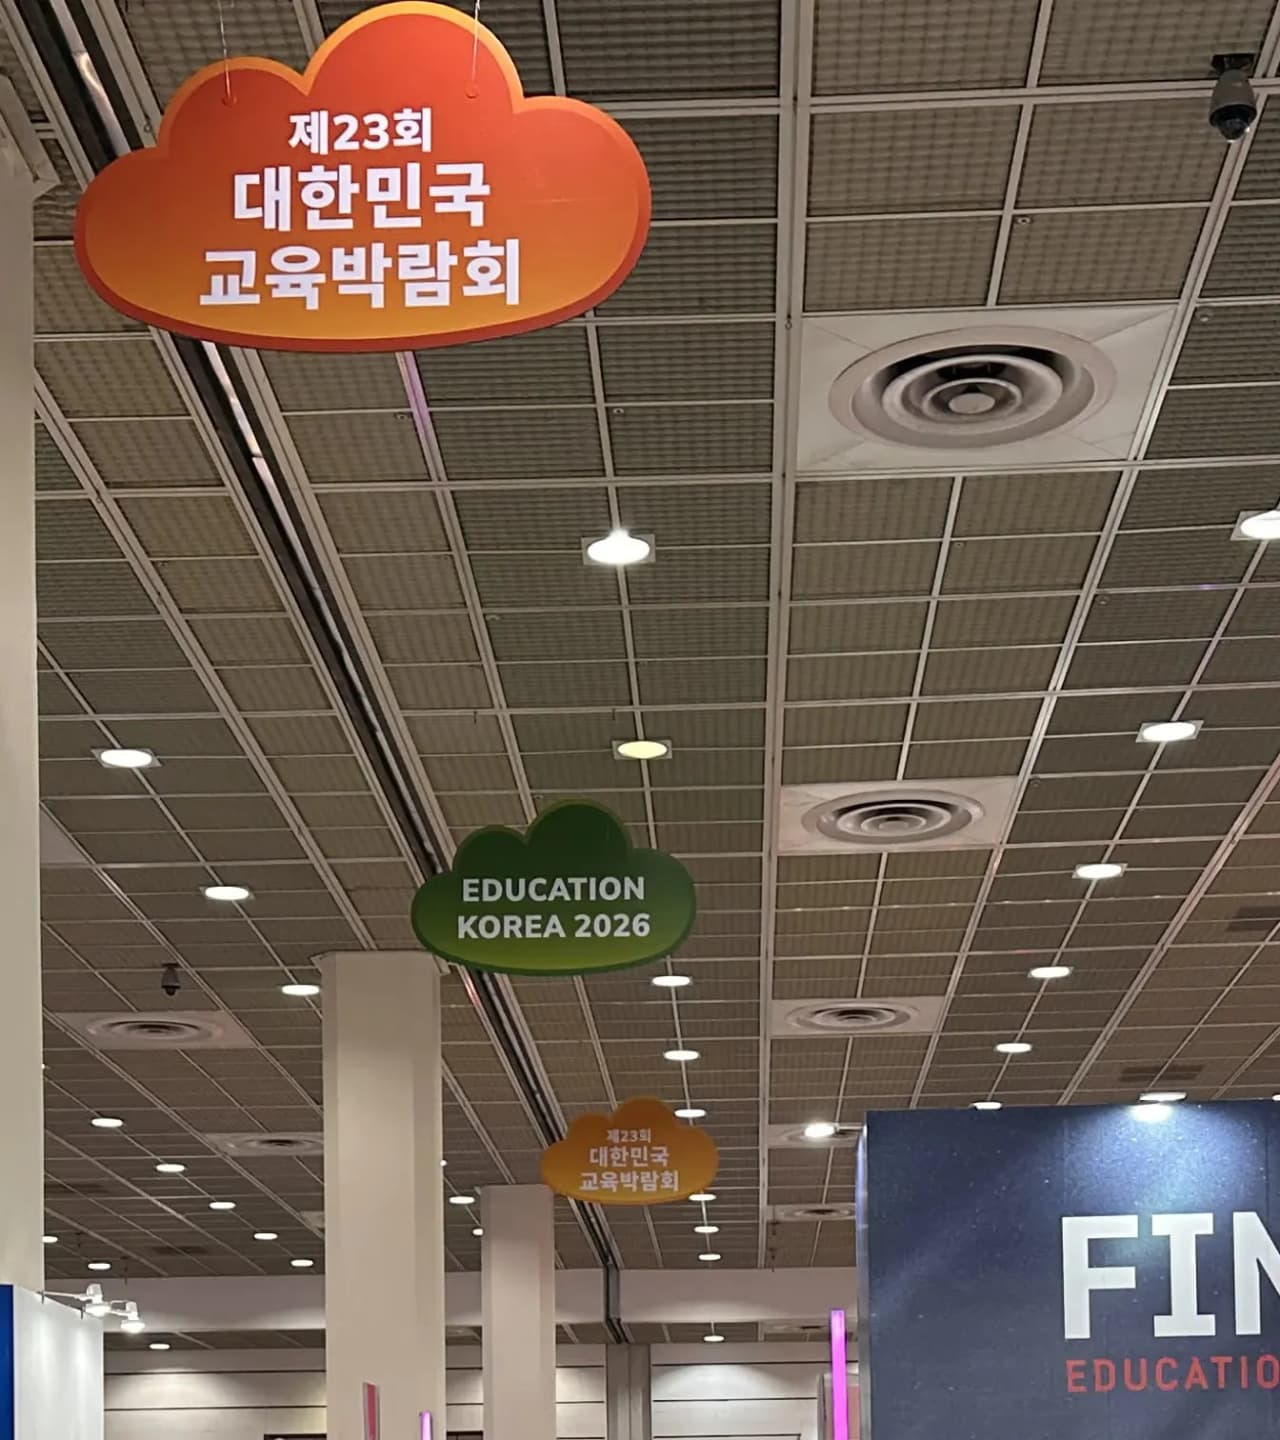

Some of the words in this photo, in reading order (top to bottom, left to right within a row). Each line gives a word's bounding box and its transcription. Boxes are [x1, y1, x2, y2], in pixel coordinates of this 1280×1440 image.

[288, 107, 433, 155] 제23회
[233, 162, 490, 232] 대한민국
[199, 238, 520, 310] 교육박람회
[462, 875, 645, 902] EDUCATION
[457, 914, 566, 939] KOREA
[575, 913, 651, 938] 2026
[606, 1128, 651, 1143] 제23회
[589, 1145, 669, 1167] 대한민국
[579, 1170, 679, 1192] 교육박람회
